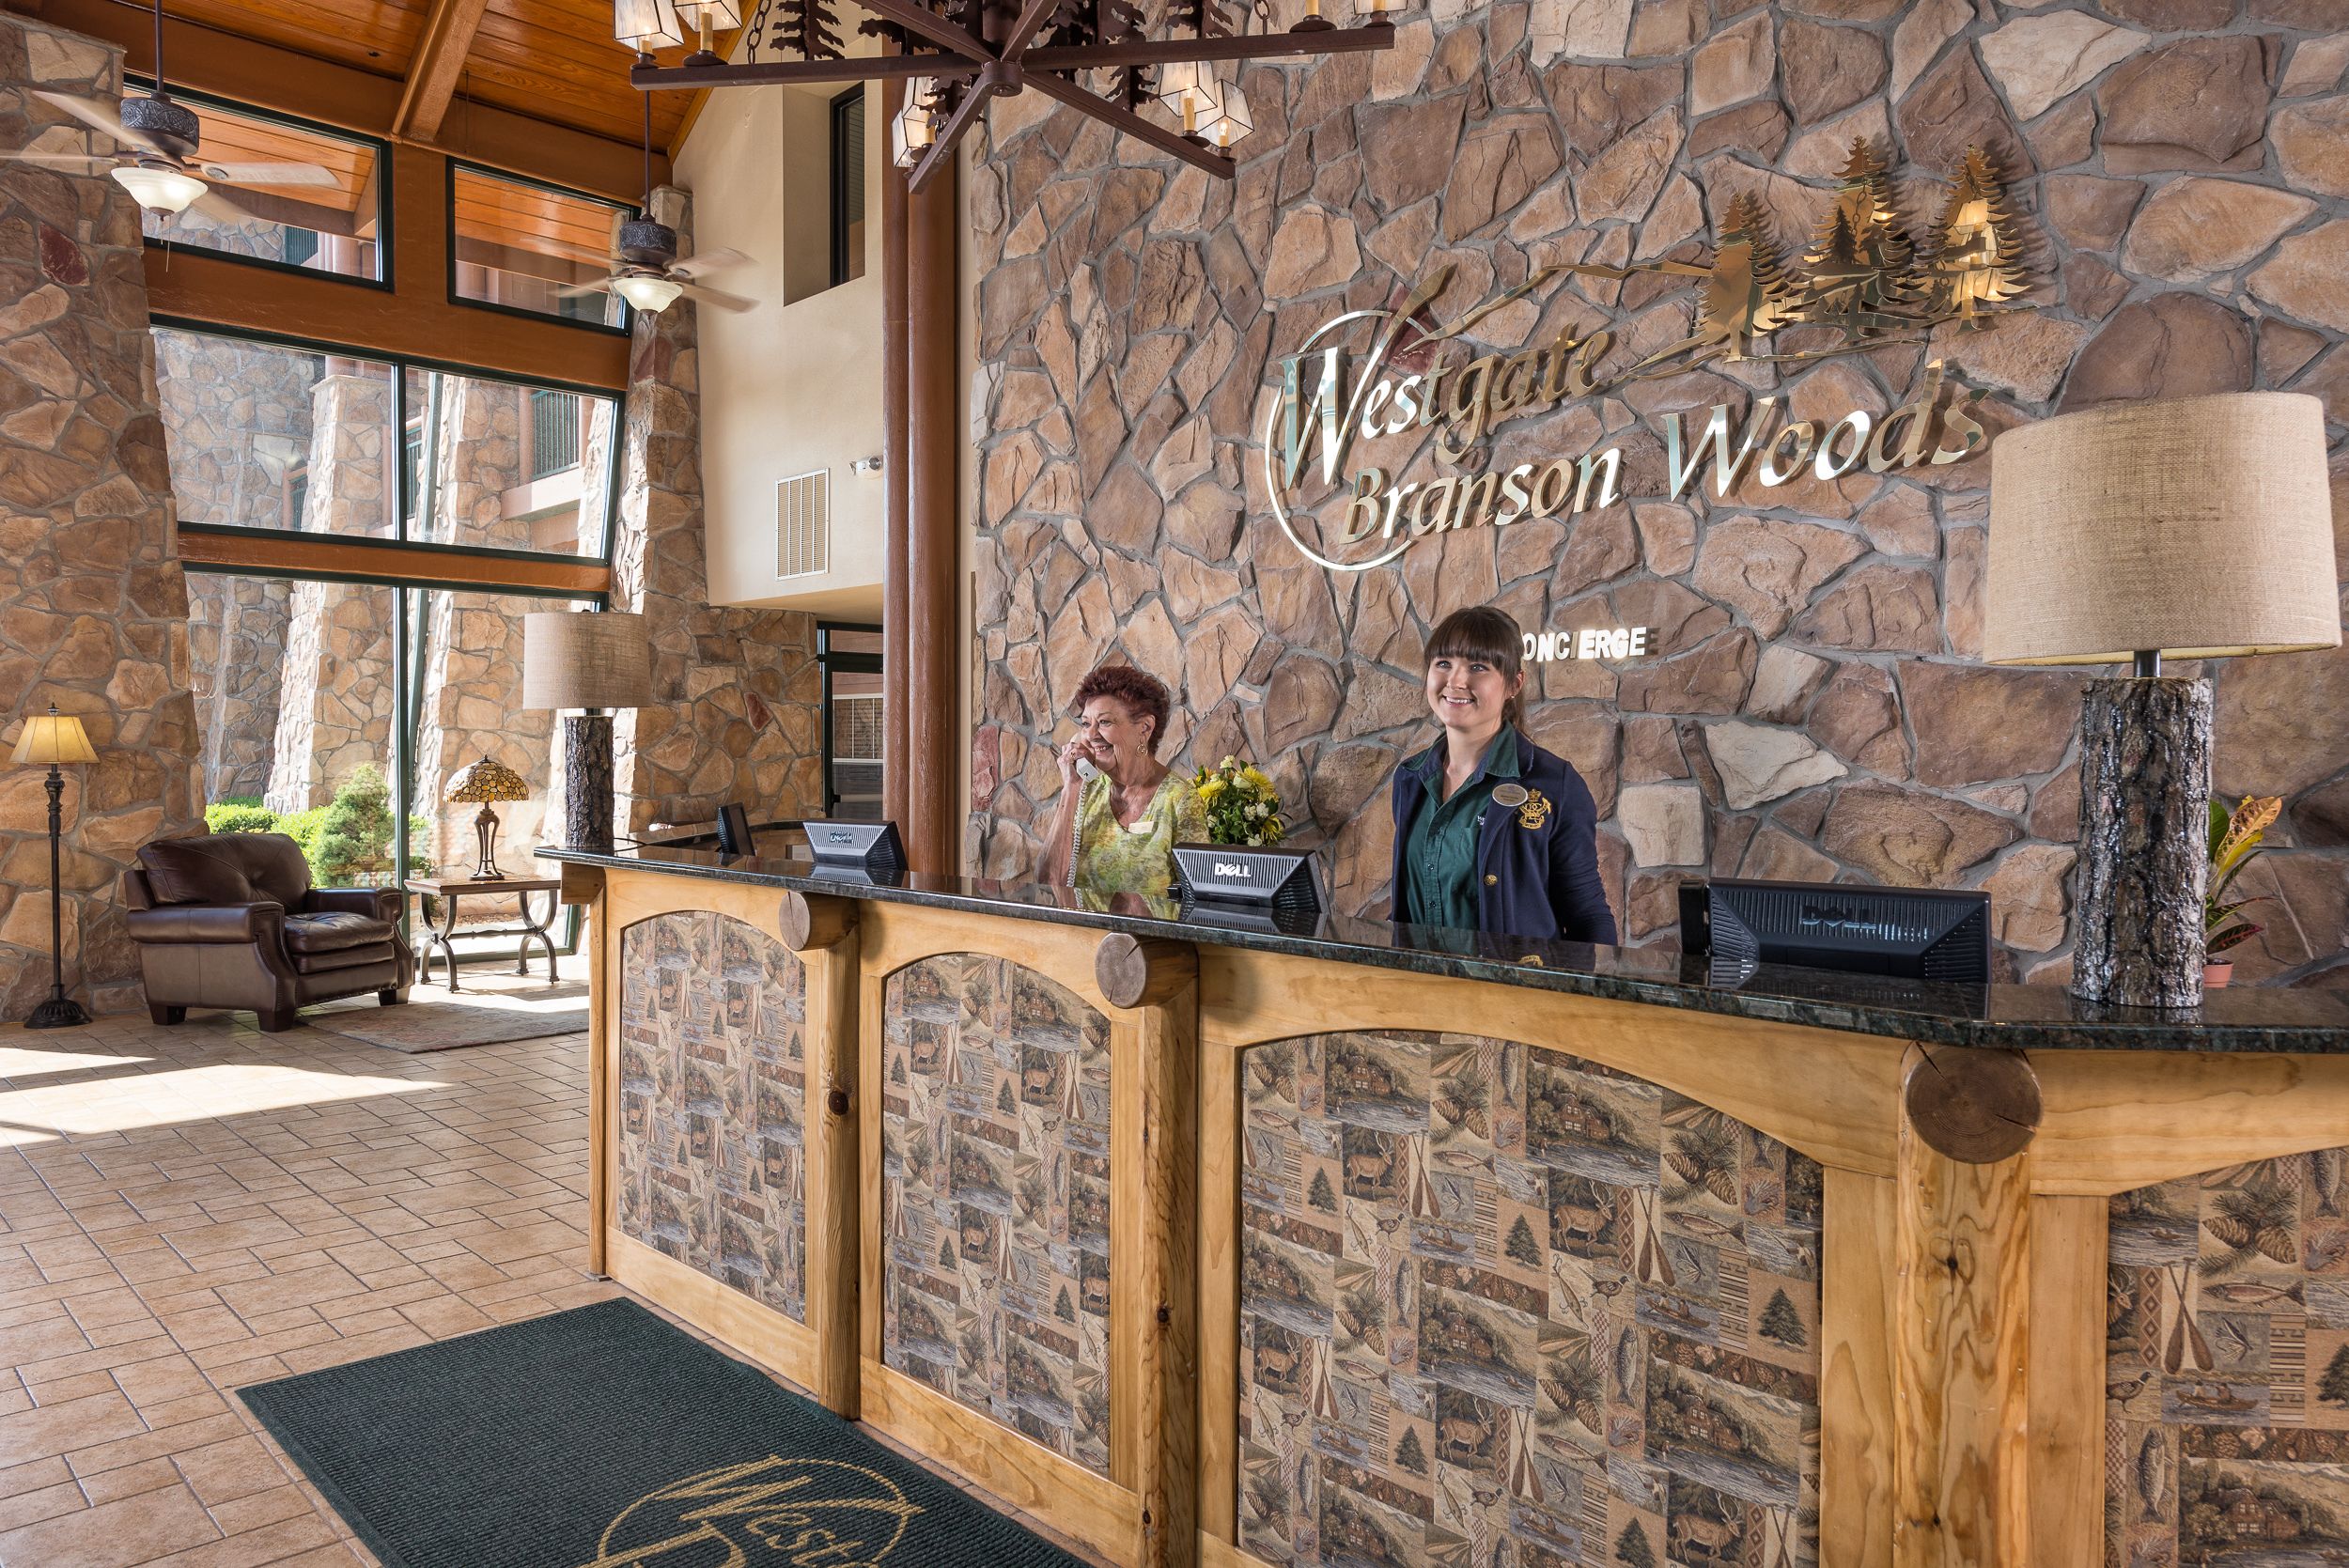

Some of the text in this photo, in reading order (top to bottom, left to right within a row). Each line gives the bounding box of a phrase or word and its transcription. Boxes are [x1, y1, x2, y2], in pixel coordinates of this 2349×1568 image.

[1279, 264, 1609, 490] Westgate
[1339, 358, 1990, 544] Branson Woods
[1522, 627, 1647, 662] ONCIERGE
[1214, 862, 1252, 877] DELL
